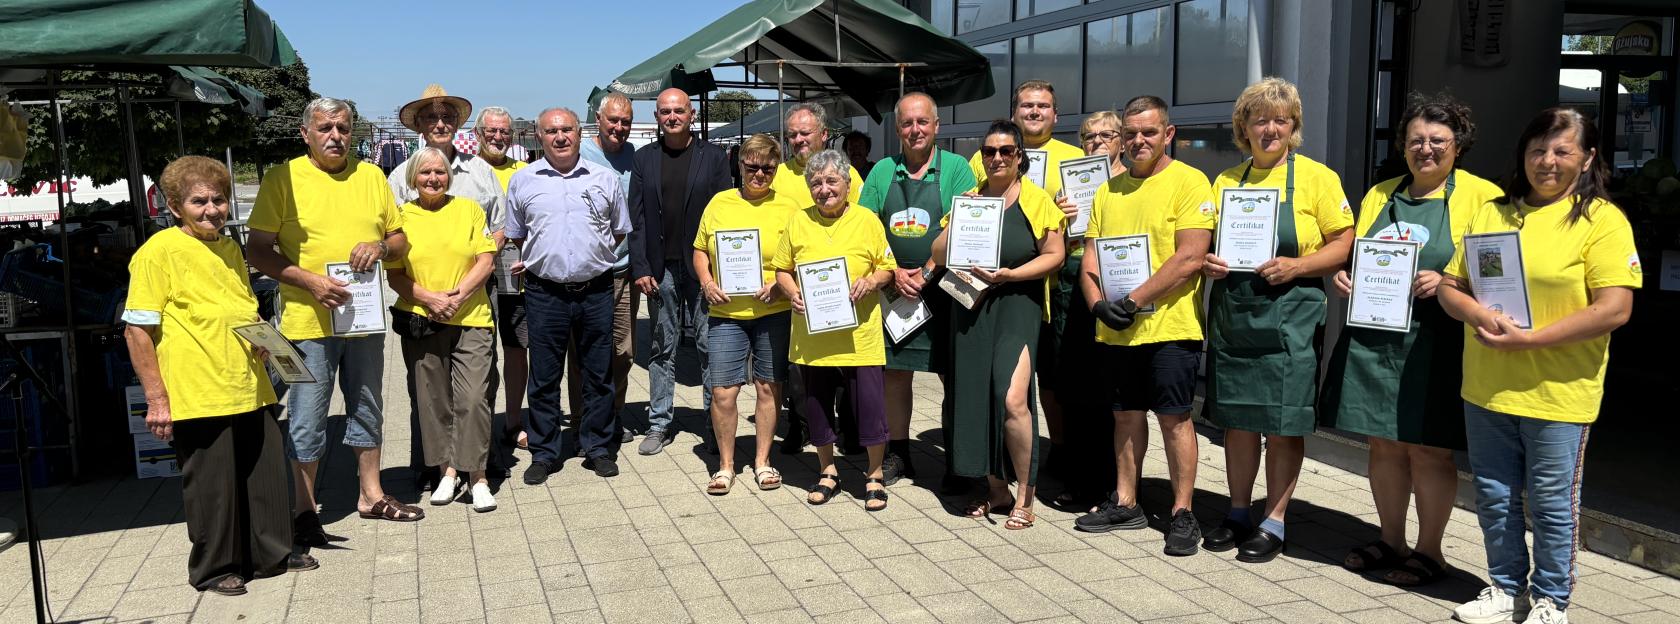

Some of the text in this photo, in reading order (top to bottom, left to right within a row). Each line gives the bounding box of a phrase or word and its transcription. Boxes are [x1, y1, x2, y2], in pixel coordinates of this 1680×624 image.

[1109, 268, 1139, 276] Certifikat
[1364, 275, 1400, 285] Certifikat
[812, 287, 841, 297] Certifikat
